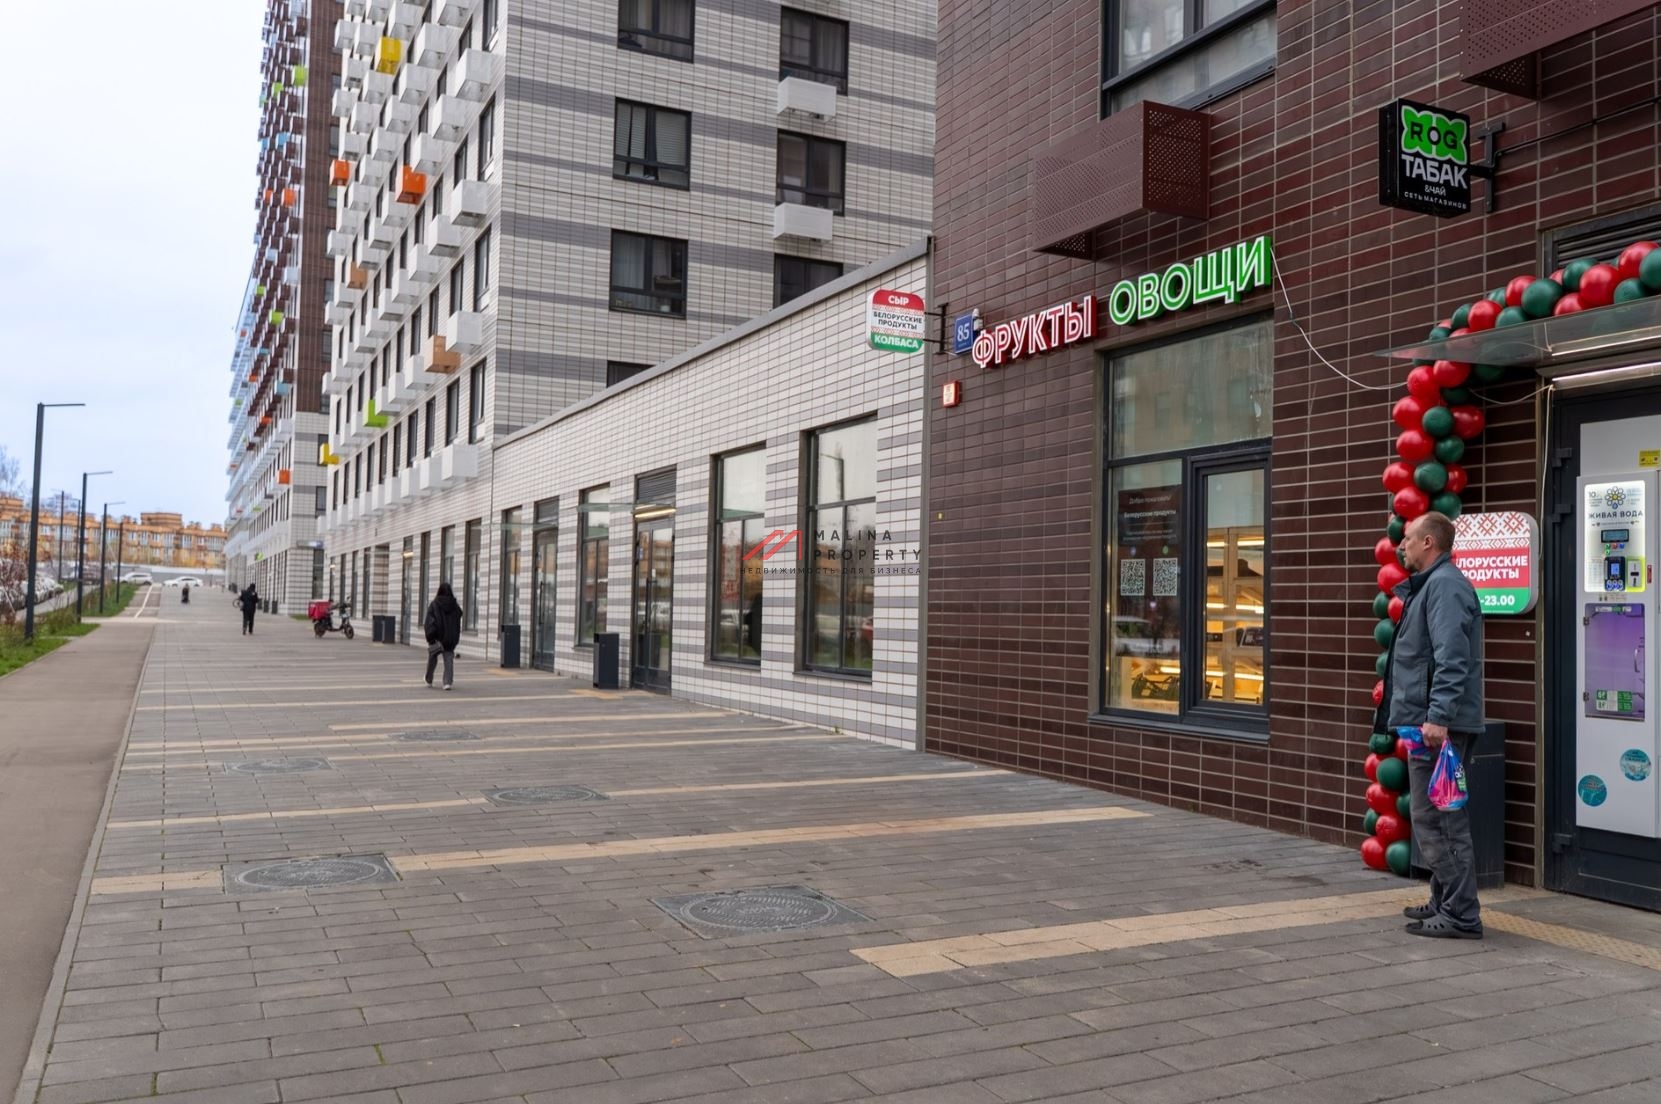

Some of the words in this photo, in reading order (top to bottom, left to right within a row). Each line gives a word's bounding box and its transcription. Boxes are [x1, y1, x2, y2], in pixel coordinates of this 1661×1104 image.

[1410, 121, 1457, 149] ROG
[1401, 154, 1468, 189] ТАБАК
[1404, 191, 1423, 200] СЕТЬ
[1423, 195, 1467, 209] МАГАЗИНОВ
[888, 295, 910, 305] СЫР
[972, 294, 1096, 369] ФРУКТЫ
[1108, 235, 1270, 326] ОВОЩИ
[873, 311, 923, 324] БЕЛОРУССКИЕ
[878, 319, 918, 330] ПРОДУКТЫ
[957, 322, 970, 342] 85
[874, 334, 919, 349] КОЛБАСА
[1588, 511, 1618, 519] ЖИВАЯ
[1620, 510, 1643, 518] ВОДА
[1455, 555, 1528, 569] ЛОРУССКИЕ
[1461, 567, 1519, 582] РОДУКТЫ
[1479, 594, 1515, 606] -23.00
